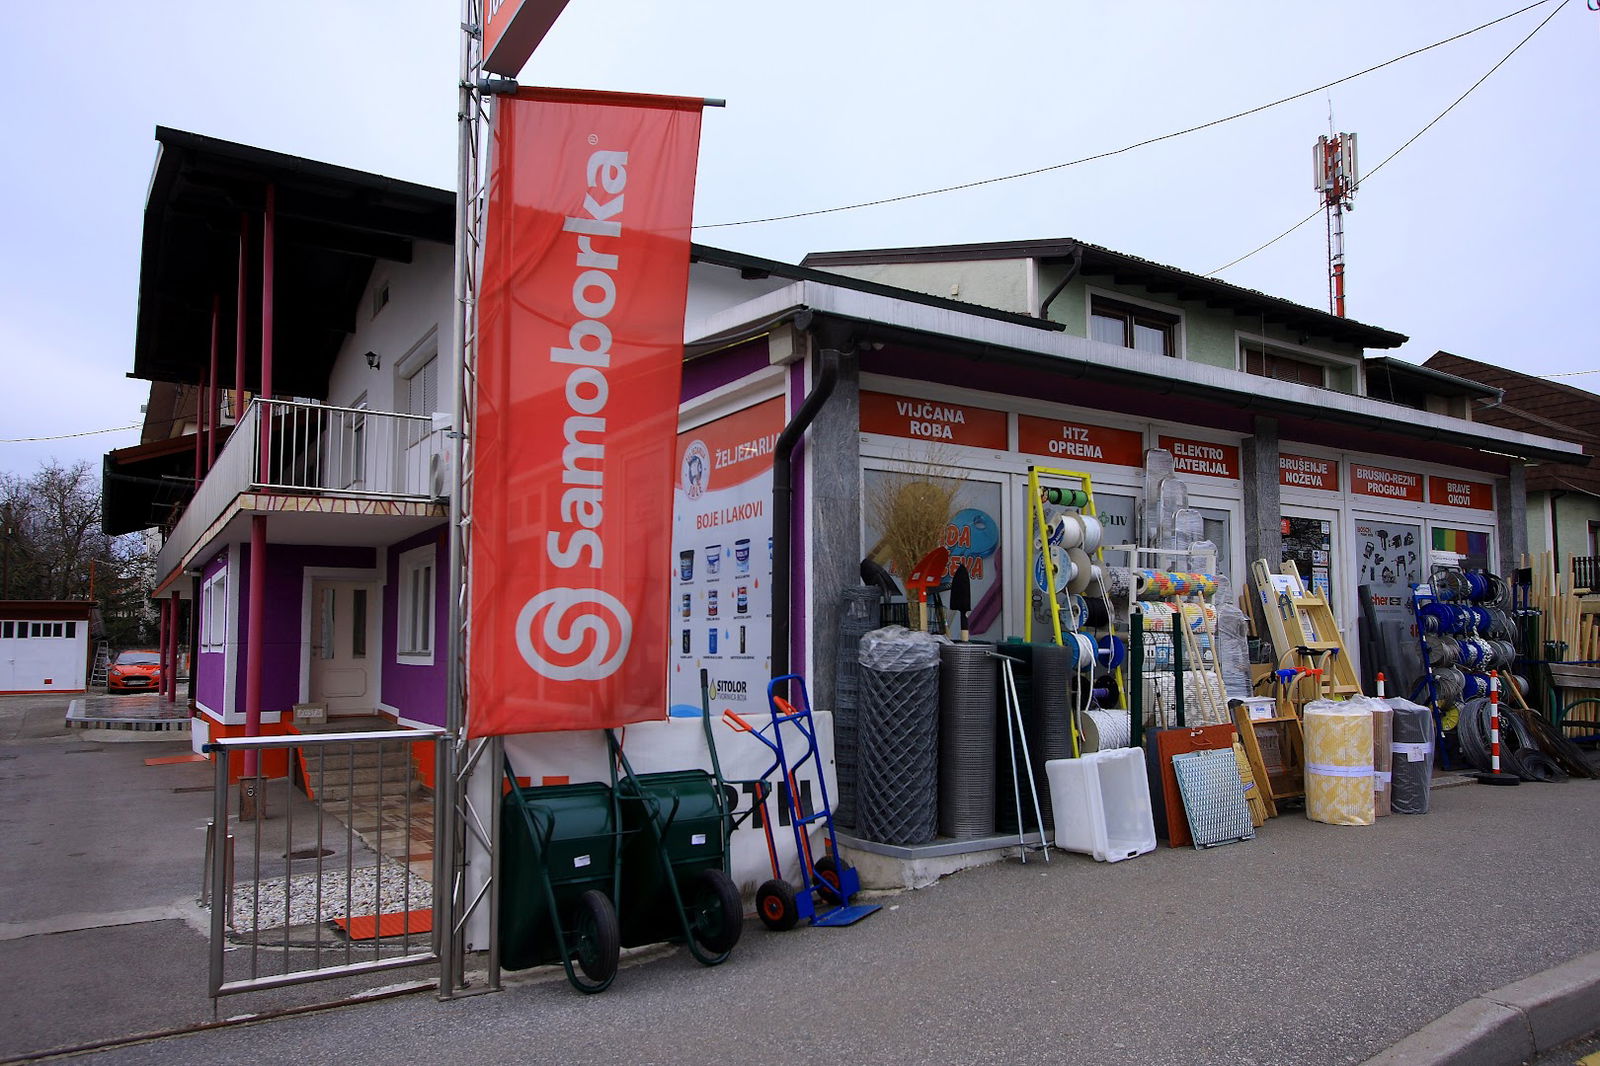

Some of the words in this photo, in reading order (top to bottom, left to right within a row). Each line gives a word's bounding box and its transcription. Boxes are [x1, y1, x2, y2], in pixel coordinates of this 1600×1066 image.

[546, 149, 629, 569] Samoborka
[897, 401, 966, 424] VIJČANA
[910, 420, 953, 440] ROBA
[1062, 426, 1089, 442] HTZ
[1048, 440, 1103, 459] OPREMA
[1173, 442, 1224, 461] ELEKTRO
[1172, 457, 1230, 476] MATERIJAL
[1279, 457, 1328, 475] BRUŠENJE
[1285, 472, 1323, 487] NOŽEVA
[1356, 468, 1416, 487] BRUSNO-REZNI
[1367, 482, 1407, 498] PROGRAM
[1447, 482, 1471, 495] BRAVE
[1448, 494, 1471, 506] OKOVI
[696, 511, 719, 530] BOJE
[721, 509, 725, 526] I
[726, 499, 763, 524] LAKOVI
[1110, 514, 1128, 526] LIV
[716, 679, 747, 693] SITOLOR
